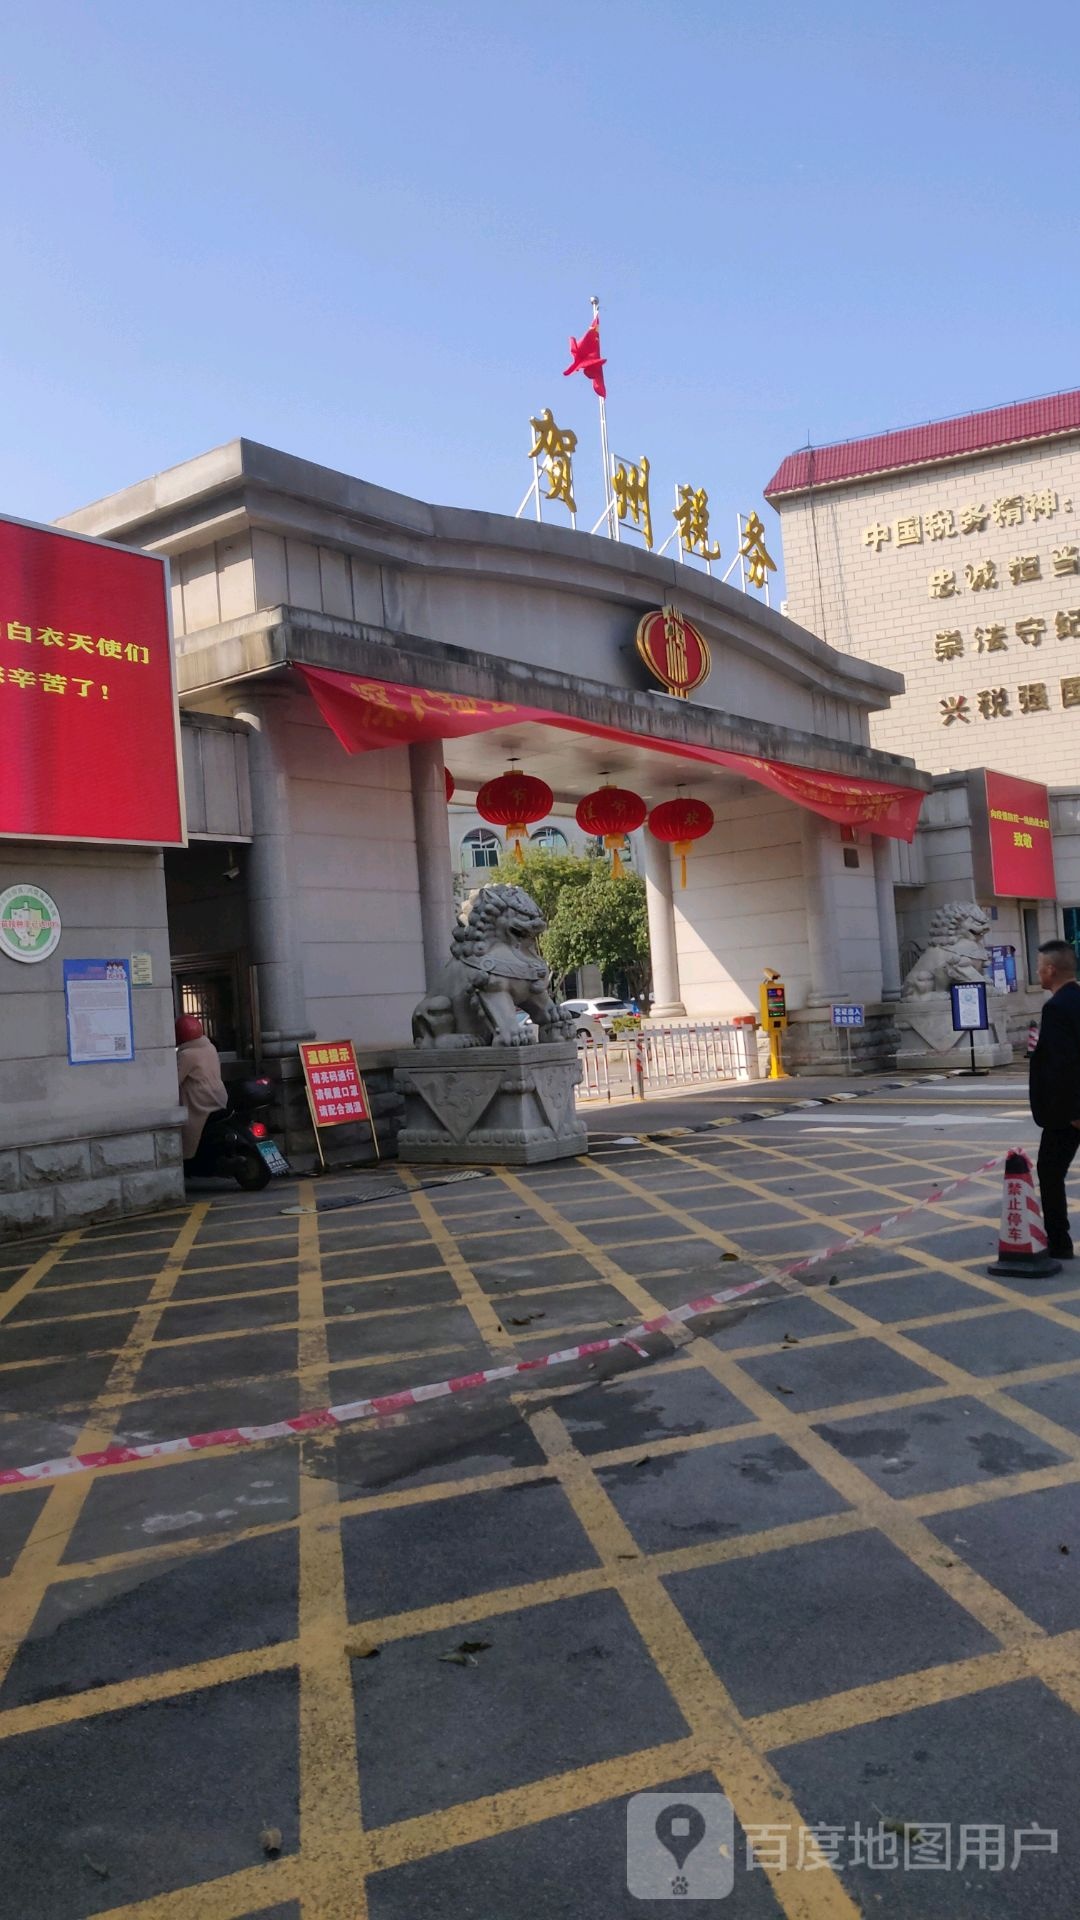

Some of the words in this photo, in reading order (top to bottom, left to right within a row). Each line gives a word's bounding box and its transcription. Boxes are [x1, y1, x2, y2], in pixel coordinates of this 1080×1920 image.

[928, 545, 1080, 600] 忠诚担当
[0, 620, 150, 665] 白衣天使们
[933, 607, 1080, 664] 崇法守纪
[939, 675, 1080, 727] 兴税强国
[1013, 831, 1033, 849] 致敬
[307, 1047, 351, 1065] 温馨提示
[312, 1069, 355, 1084] 请亮码通行
[315, 1084, 359, 1101] 请佩戴口罩
[319, 1101, 363, 1117] 请配合测温
[1007, 1182, 1023, 1242] 禁止停车
